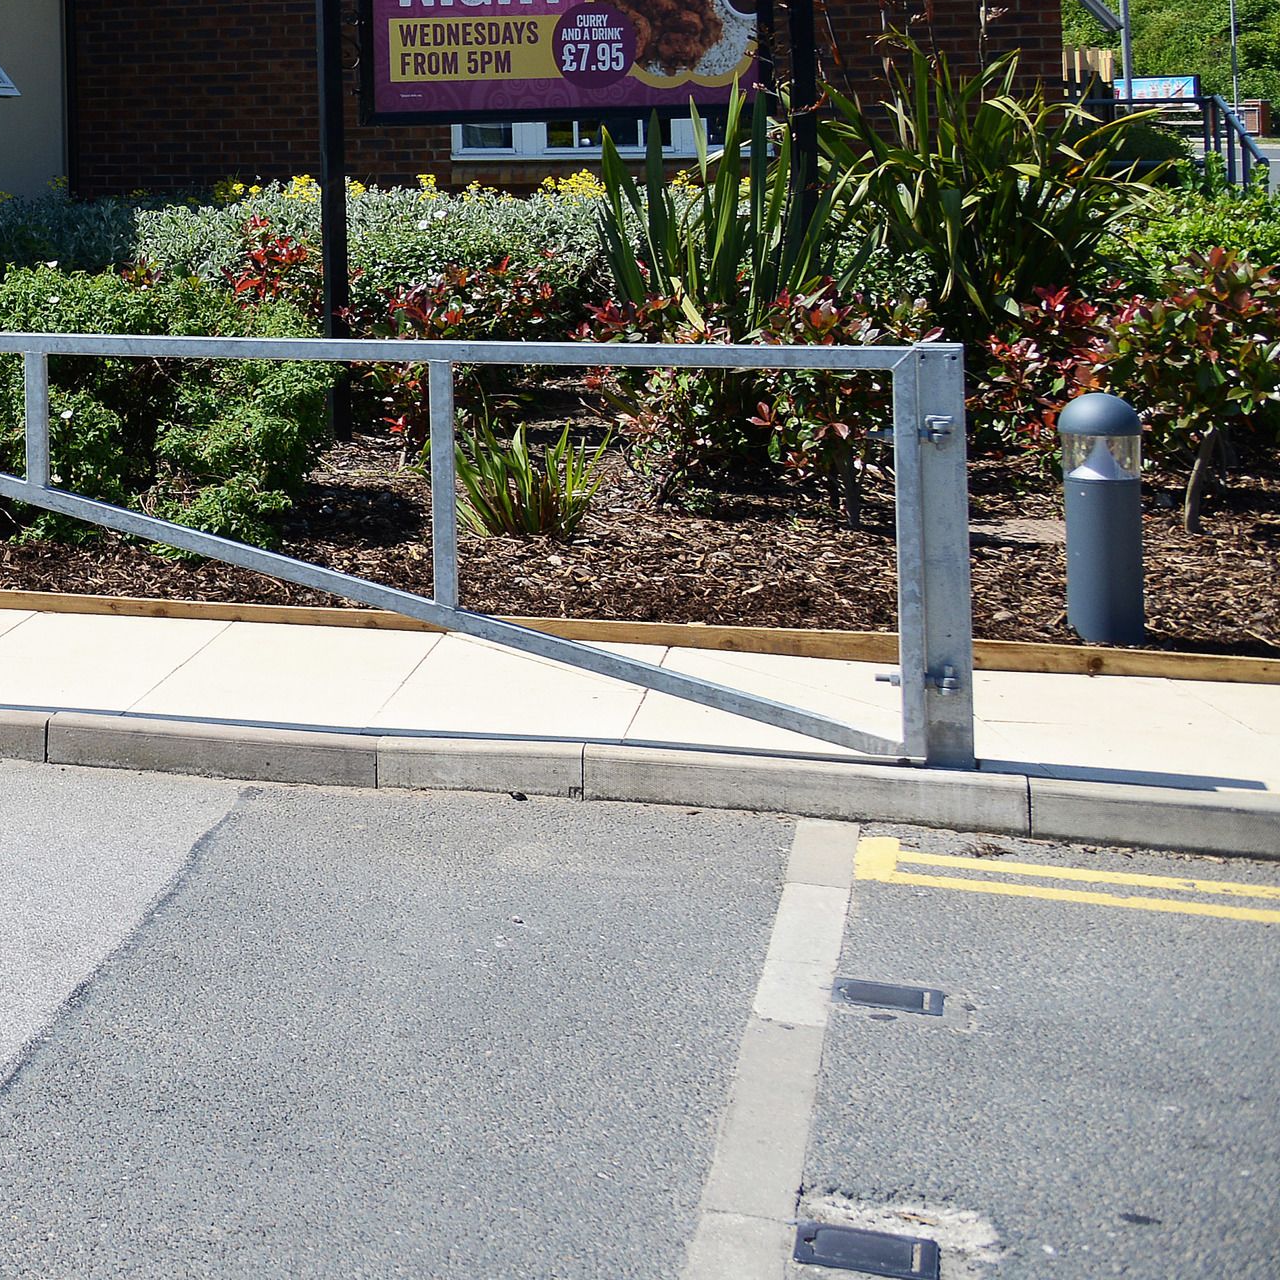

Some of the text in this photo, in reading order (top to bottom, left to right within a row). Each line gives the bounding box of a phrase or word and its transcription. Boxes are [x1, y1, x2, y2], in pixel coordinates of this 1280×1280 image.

[576, 14, 608, 27] CURRY
[399, 21, 539, 47] WEDNESDAYS
[561, 28, 581, 40] AND
[583, 28, 590, 40] A
[400, 50, 512, 75] FROM 5PM
[561, 43, 624, 72] £7.95
